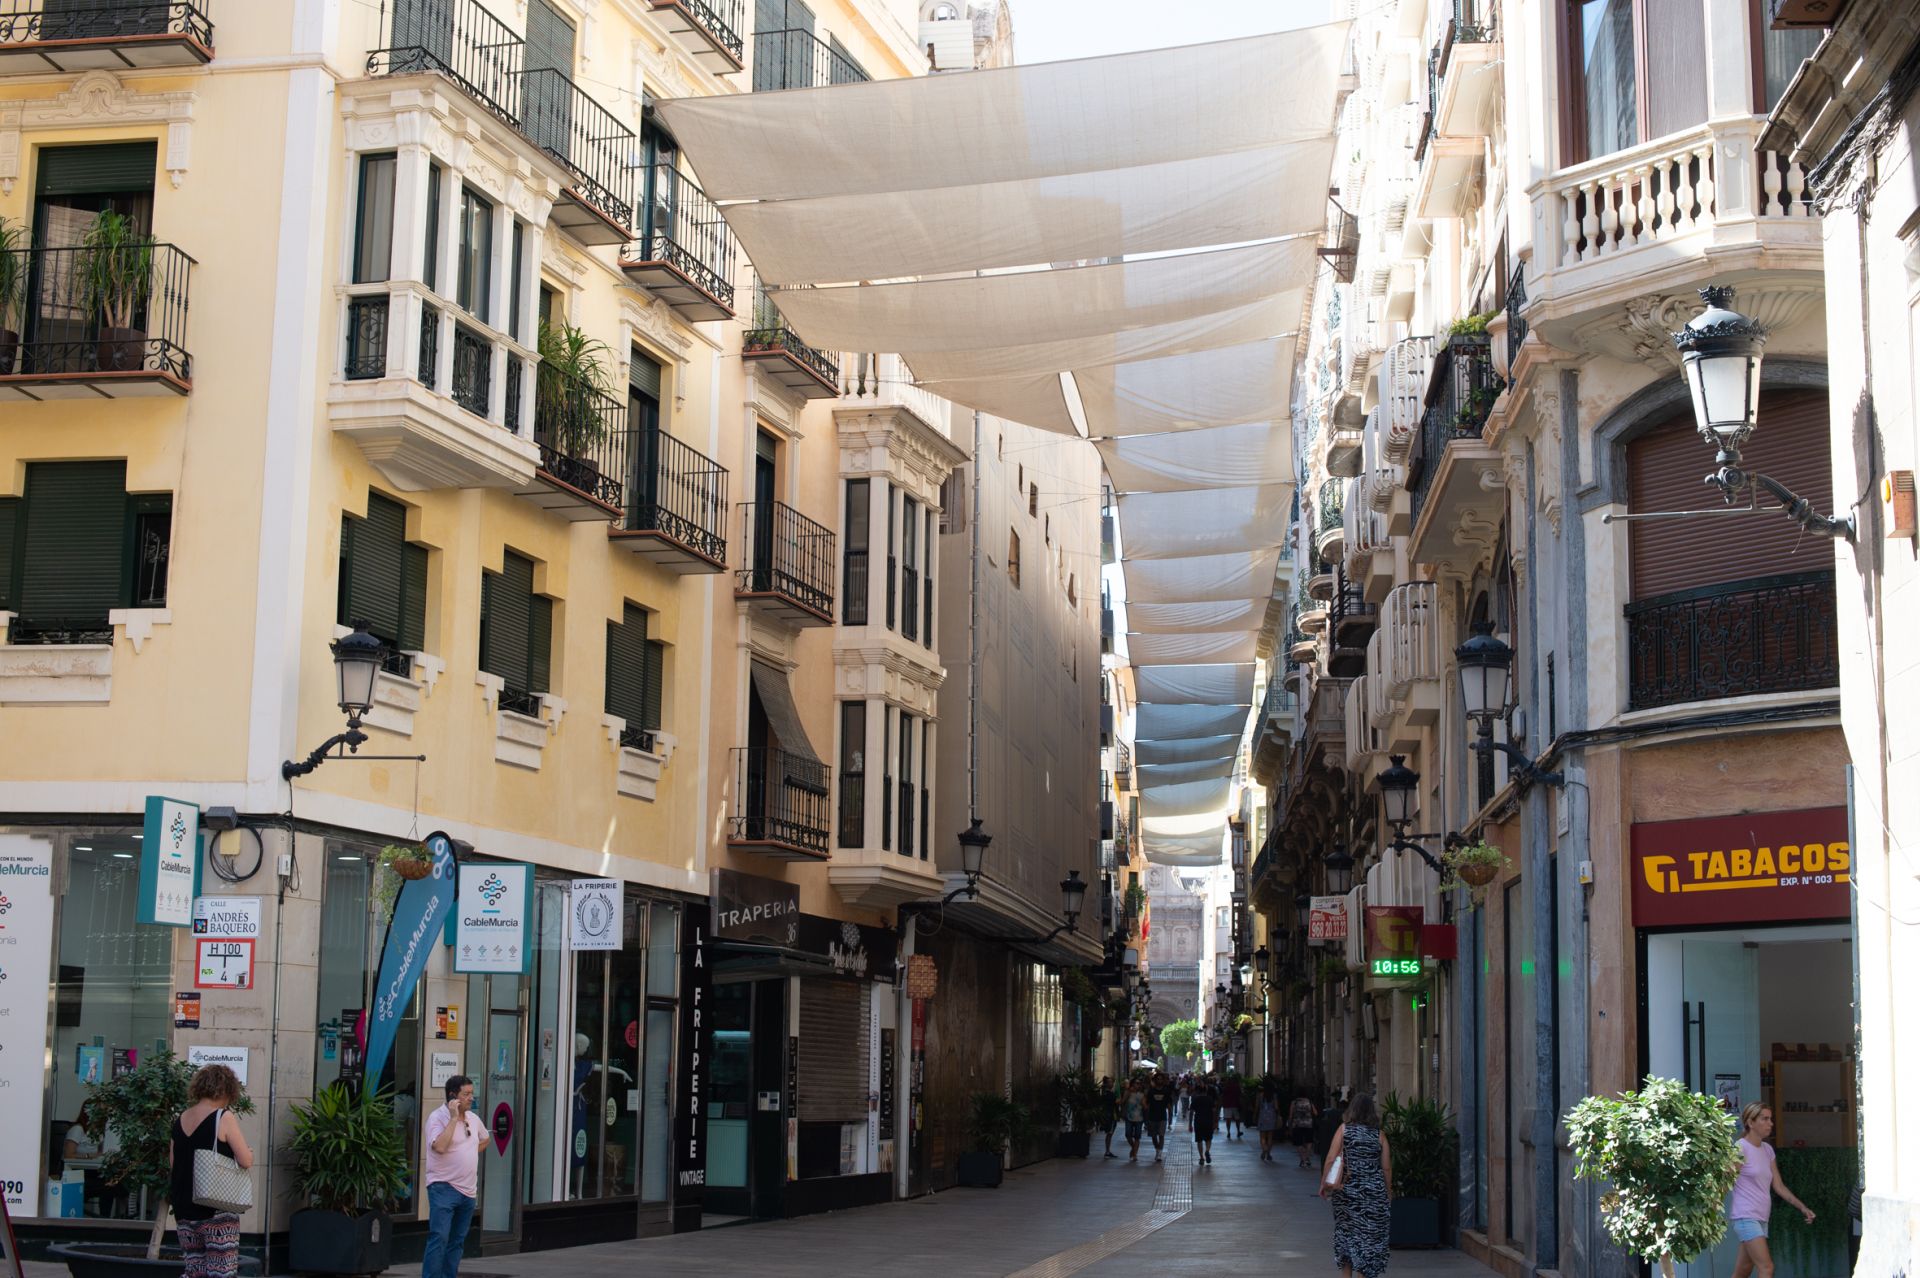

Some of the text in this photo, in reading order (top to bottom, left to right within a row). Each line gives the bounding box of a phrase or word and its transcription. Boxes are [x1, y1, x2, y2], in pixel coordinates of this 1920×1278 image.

[161, 860, 191, 875] CableMurcia
[1688, 842, 1849, 880] TABACOS
[1780, 877, 1800, 887] EXP.
[1814, 874, 1832, 884] 003
[210, 909, 249, 923] ANDRÉS
[719, 899, 797, 928] TRAPERIA
[210, 922, 257, 935] BAQUERO
[463, 917, 518, 927] CableMurcia
[786, 922, 797, 944] 36
[1312, 922, 1325, 938] 968
[1325, 922, 1332, 937] 20
[1333, 921, 1339, 937] 33
[210, 943, 241, 955] H 100
[390, 895, 440, 999] CableMurcia
[1374, 961, 1420, 974] 10:56
[220, 971, 228, 982] 4
[690, 927, 703, 1158] LA FRIPERIE
[203, 1054, 244, 1062] CableMurcia
[680, 1169, 704, 1186] VINTAGE
